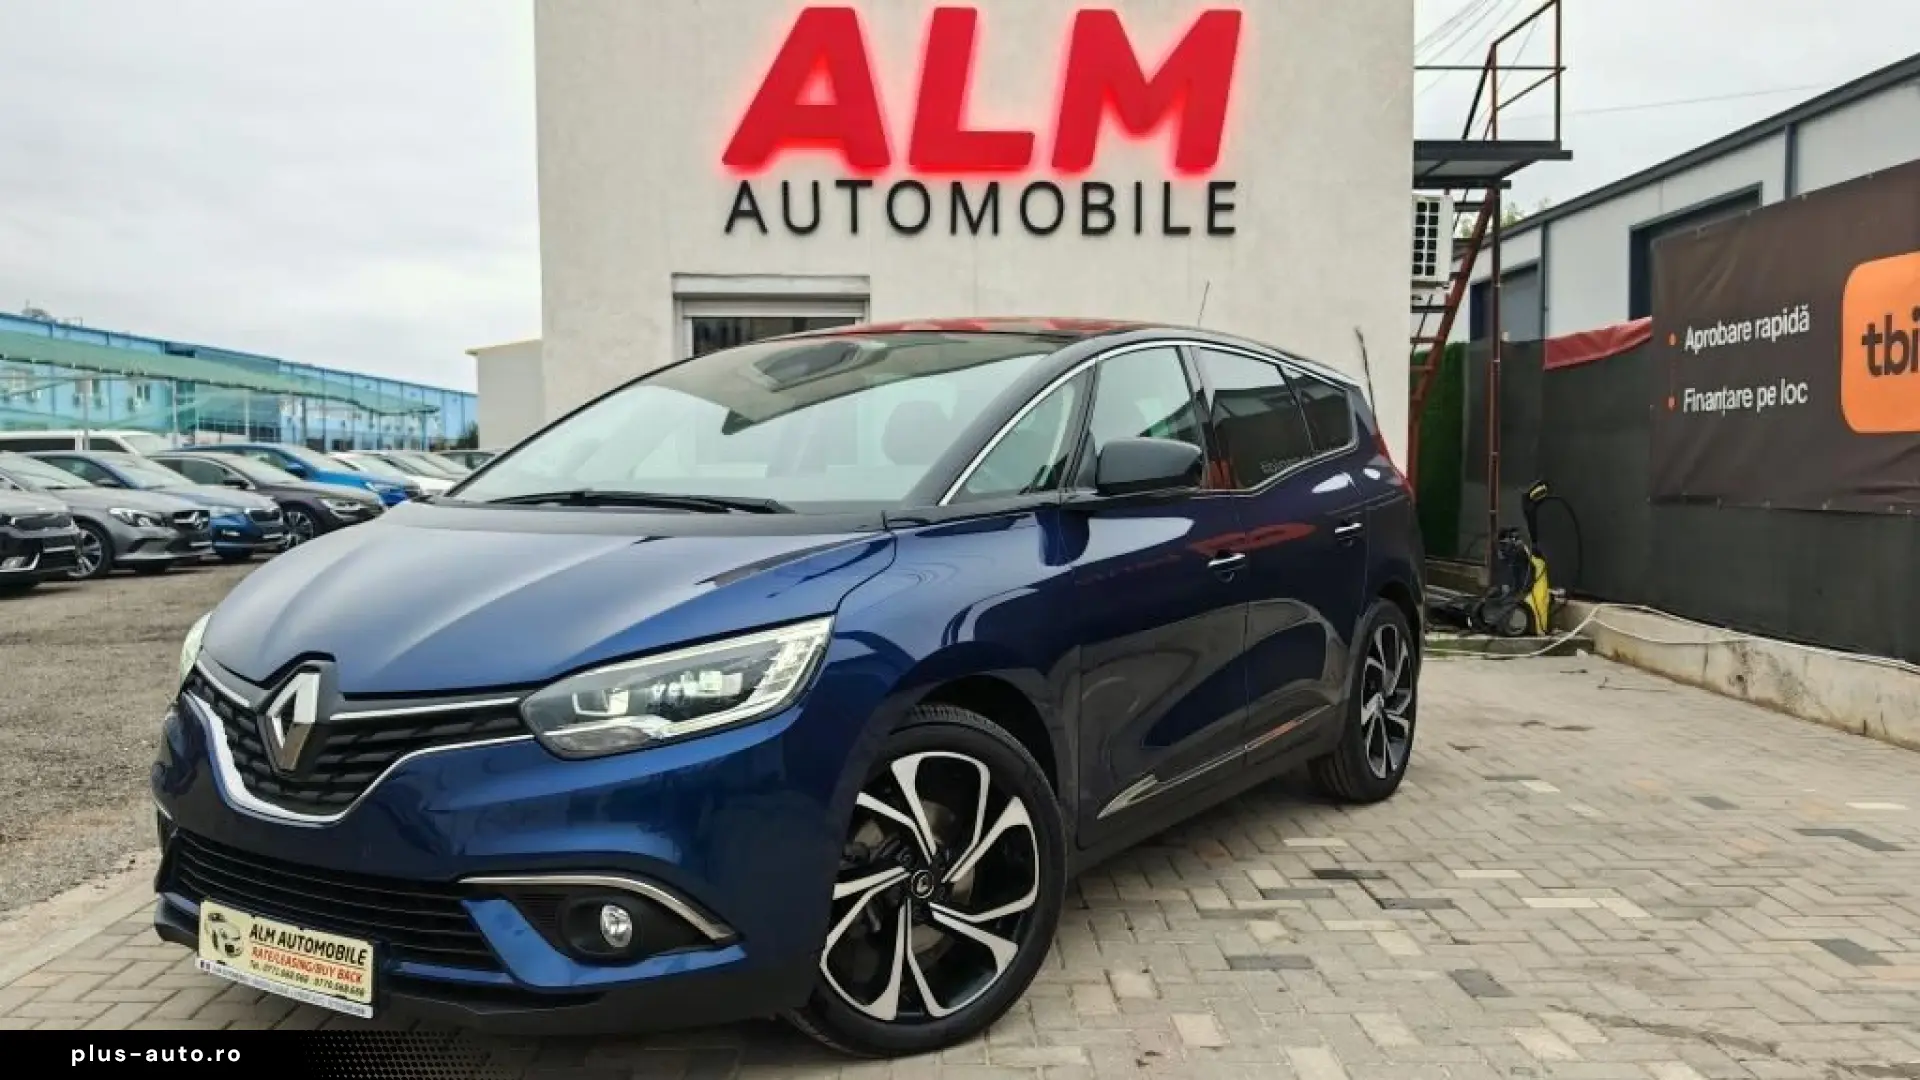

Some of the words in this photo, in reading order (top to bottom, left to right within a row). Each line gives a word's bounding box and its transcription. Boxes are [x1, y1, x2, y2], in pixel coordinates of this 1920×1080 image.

[721, 7, 1242, 169] ALM
[724, 179, 1237, 236] AUTOMOBILE
[1684, 320, 1752, 355] Aprobare
[1754, 304, 1811, 343] rapidă
[1756, 389, 1777, 413] pe
[1780, 378, 1809, 406] loc
[249, 923, 275, 944] ALM
[277, 930, 368, 966] AUTOMOBILE
[337, 967, 363, 984] BACK
